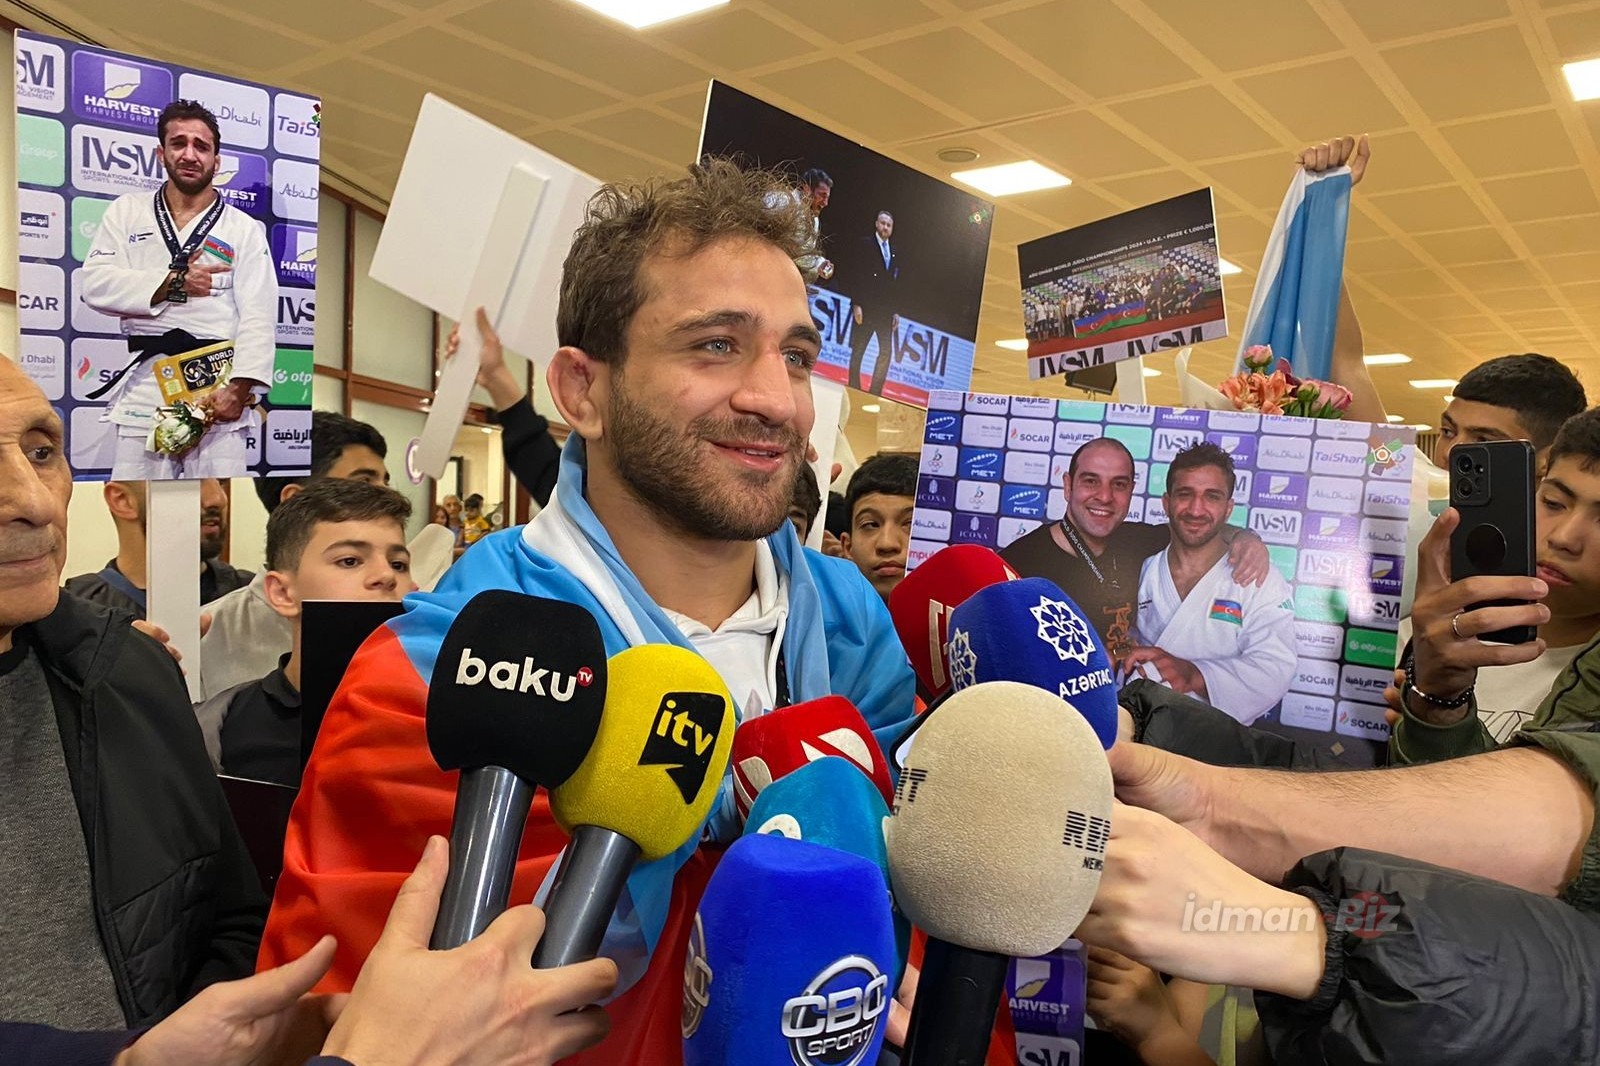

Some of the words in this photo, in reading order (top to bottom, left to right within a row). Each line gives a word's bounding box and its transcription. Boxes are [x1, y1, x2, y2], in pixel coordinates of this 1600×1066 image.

[84, 95, 161, 117] HARVEST
[85, 106, 127, 119] HARVEST
[82, 136, 163, 179] IVSM
[81, 169, 136, 181] INTERNATIONAL
[83, 175, 111, 184] SPORTS
[220, 188, 257, 201] VEST
[1053, 262, 1071, 271] WORLD
[1072, 257, 1086, 266] JUDO
[1086, 245, 1128, 262] CHAMPIONSHIPS
[1129, 241, 1142, 250] 2024
[1166, 230, 1183, 239] PRIZE
[26, 354, 56, 364] Dhabi
[207, 349, 234, 362] WORLD
[290, 371, 312, 386] otp
[977, 396, 1007, 406] SOCAR
[1162, 413, 1200, 421] HARVEST
[929, 432, 954, 440] MET
[1020, 433, 1050, 443] SOCAR
[1315, 451, 1365, 464] TaiShan
[970, 469, 996, 477] MET
[1258, 492, 1299, 501] HARVEST
[1013, 506, 1039, 515] MET
[1254, 513, 1297, 533] IVSM
[959, 530, 988, 540] ICONA
[1076, 543, 1105, 584] CHAMPIONSHIPS
[455, 648, 577, 702] baku
[578, 670, 592, 683] TV
[1299, 674, 1335, 686] SOCAR
[1059, 668, 1112, 699] AZƏRTAC
[656, 699, 714, 756] itv
[1350, 719, 1388, 732] SOCAR
[781, 974, 888, 1038] CBC
[807, 1023, 873, 1057] SPORT
